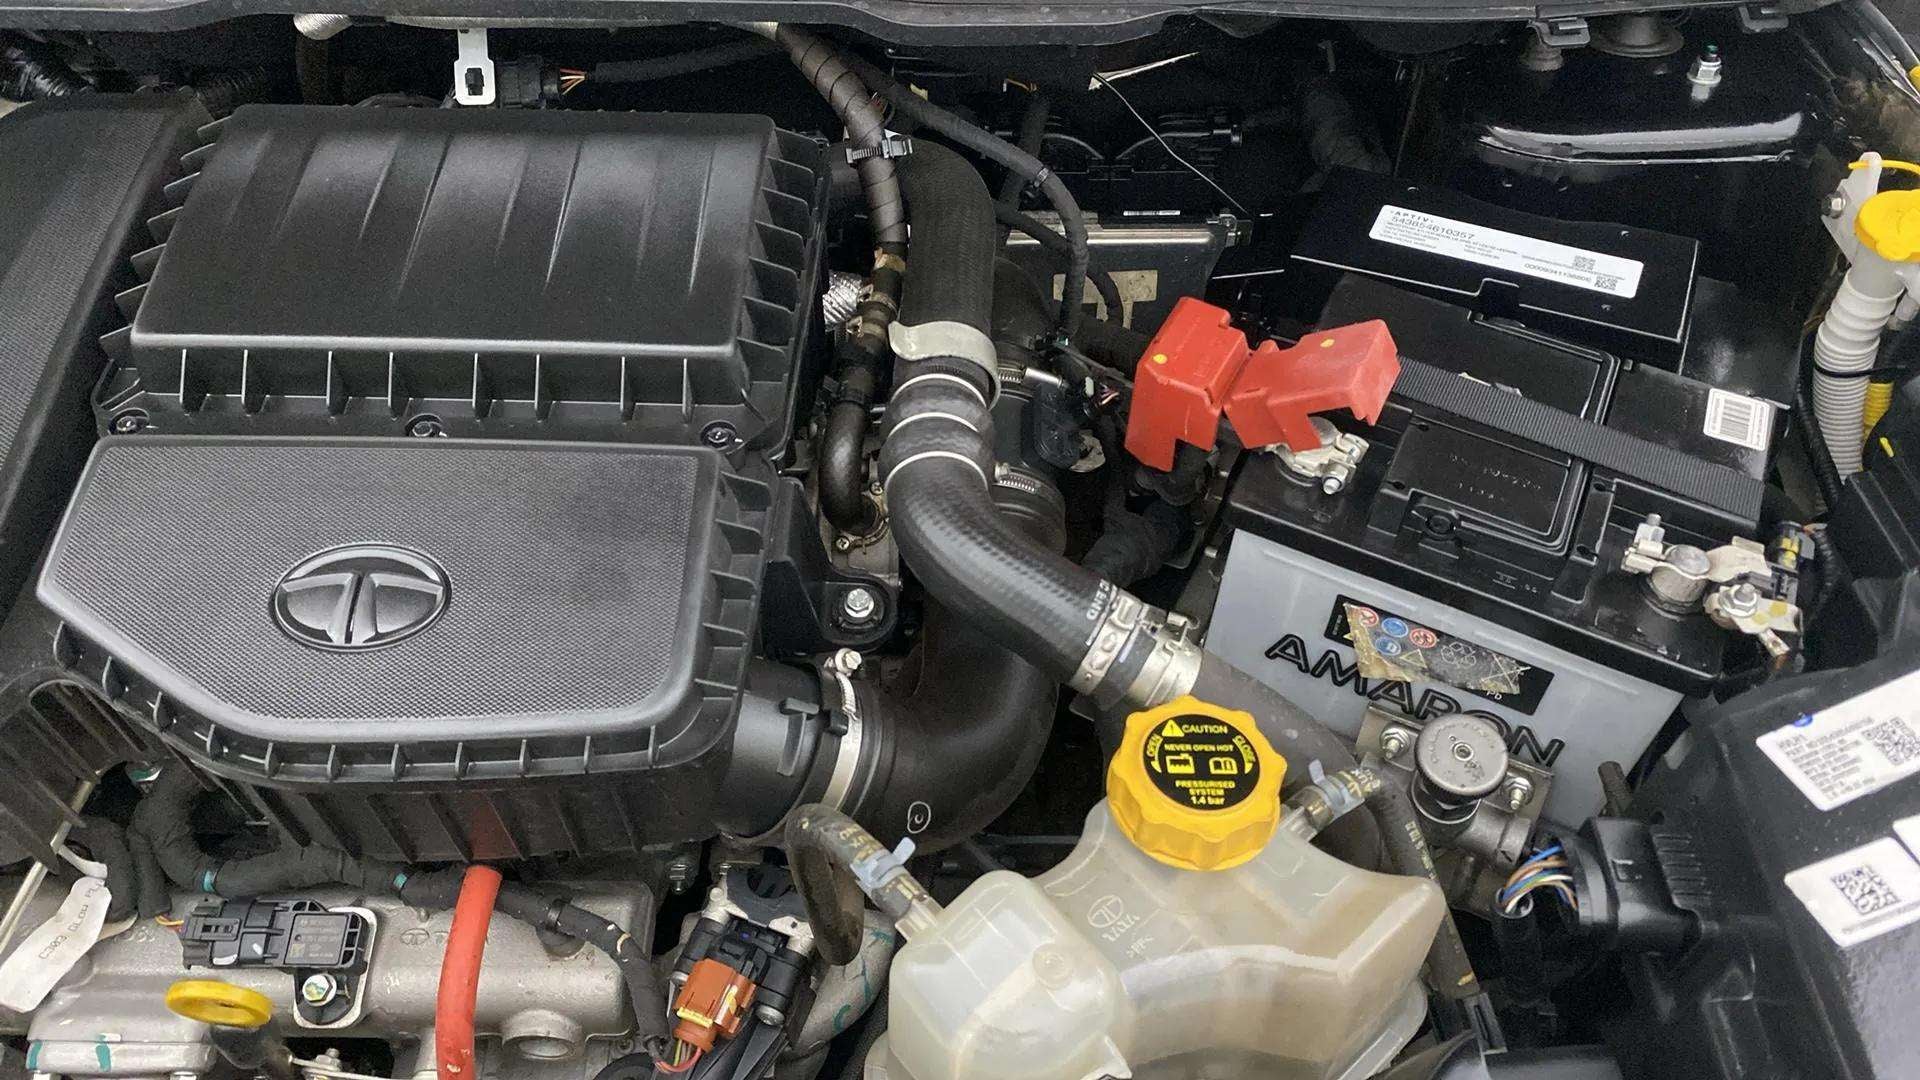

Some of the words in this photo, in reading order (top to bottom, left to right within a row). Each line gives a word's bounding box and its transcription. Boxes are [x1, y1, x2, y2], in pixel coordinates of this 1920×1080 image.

[1086, 592, 1106, 620] END
[1182, 725, 1228, 734] CAUTION
[1146, 733, 1163, 757] OPEN
[1193, 744, 1216, 752] OPEN
[1217, 744, 1234, 752] HOT
[1233, 735, 1256, 763] CLOSE
[1175, 780, 1236, 789] PRESSURISED
[1189, 788, 1225, 796] SYSTEM
[1192, 796, 1206, 805] 1.4
[1207, 796, 1225, 805] bar
